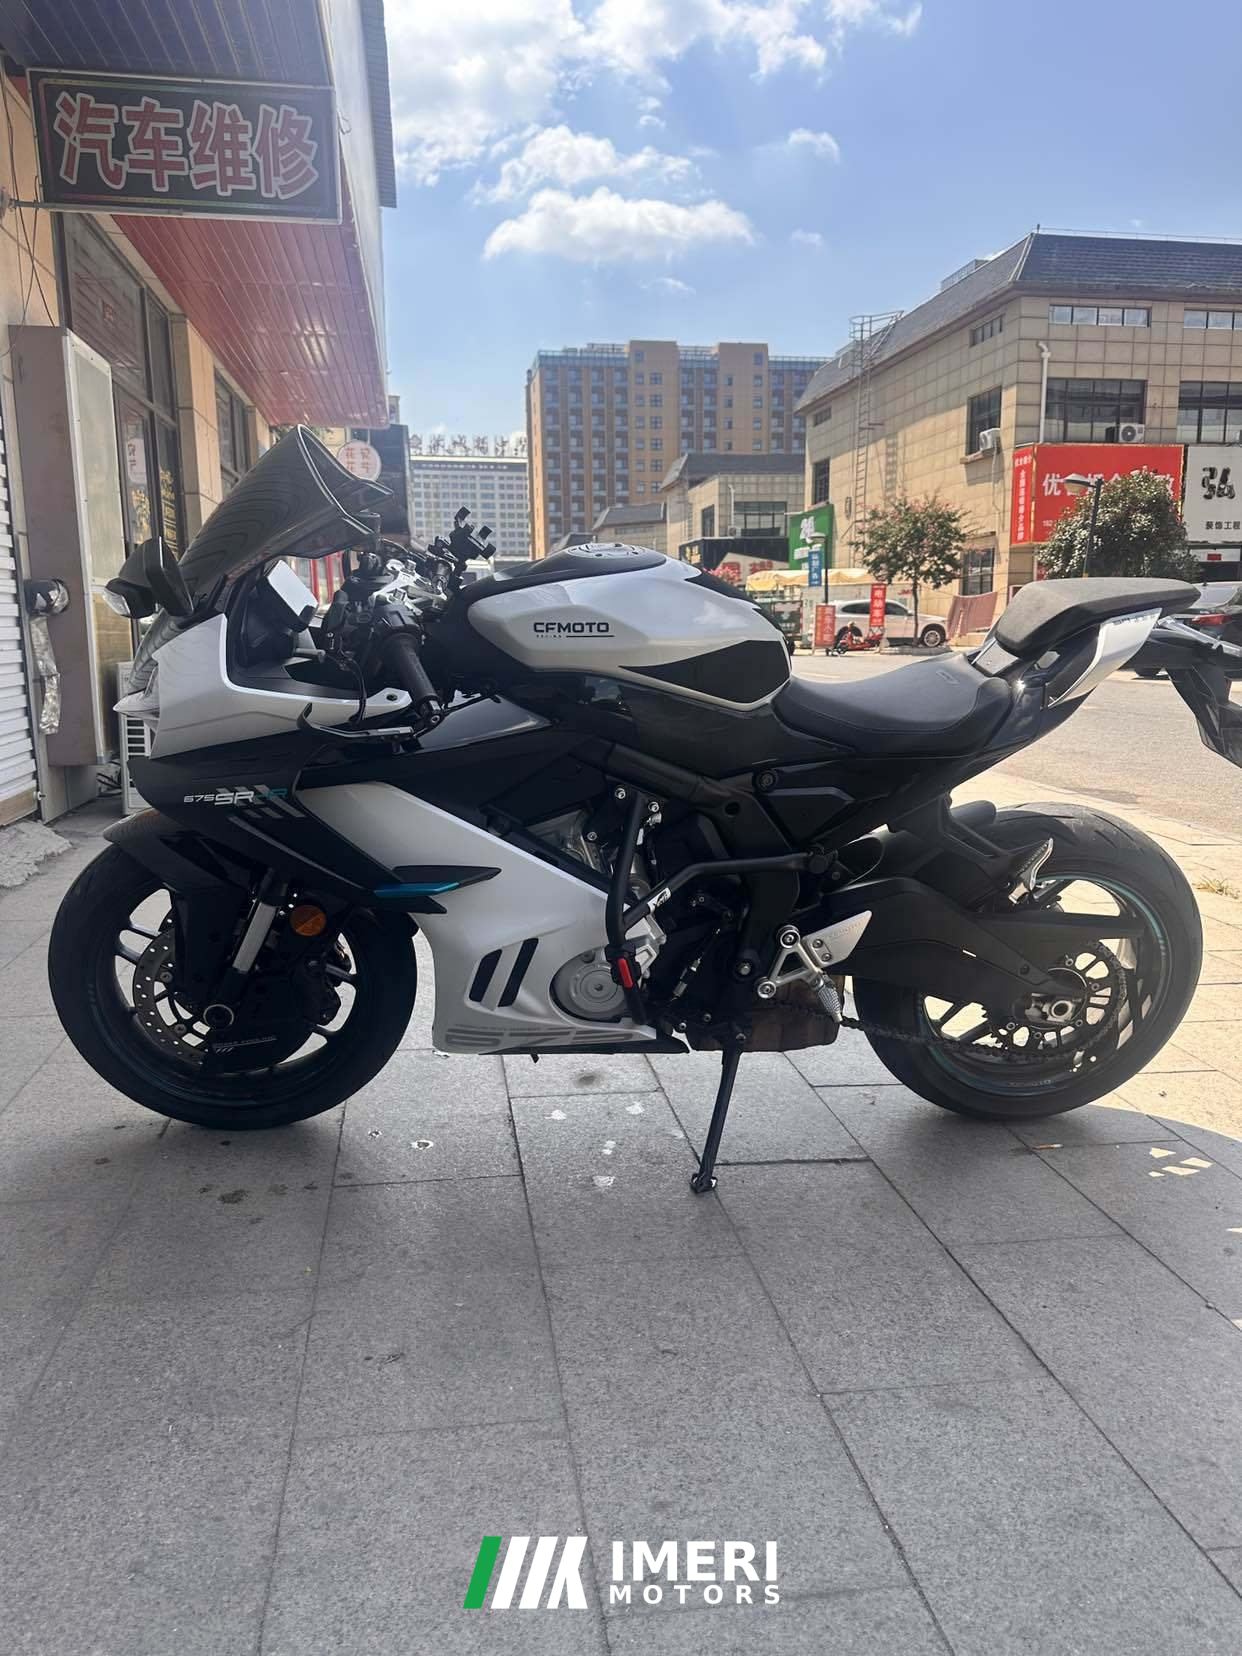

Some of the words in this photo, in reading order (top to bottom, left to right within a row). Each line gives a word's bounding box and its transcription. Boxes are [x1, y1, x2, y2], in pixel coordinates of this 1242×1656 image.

[53, 91, 319, 200] 汽车维修
[533, 622, 610, 633] CFMOTO
